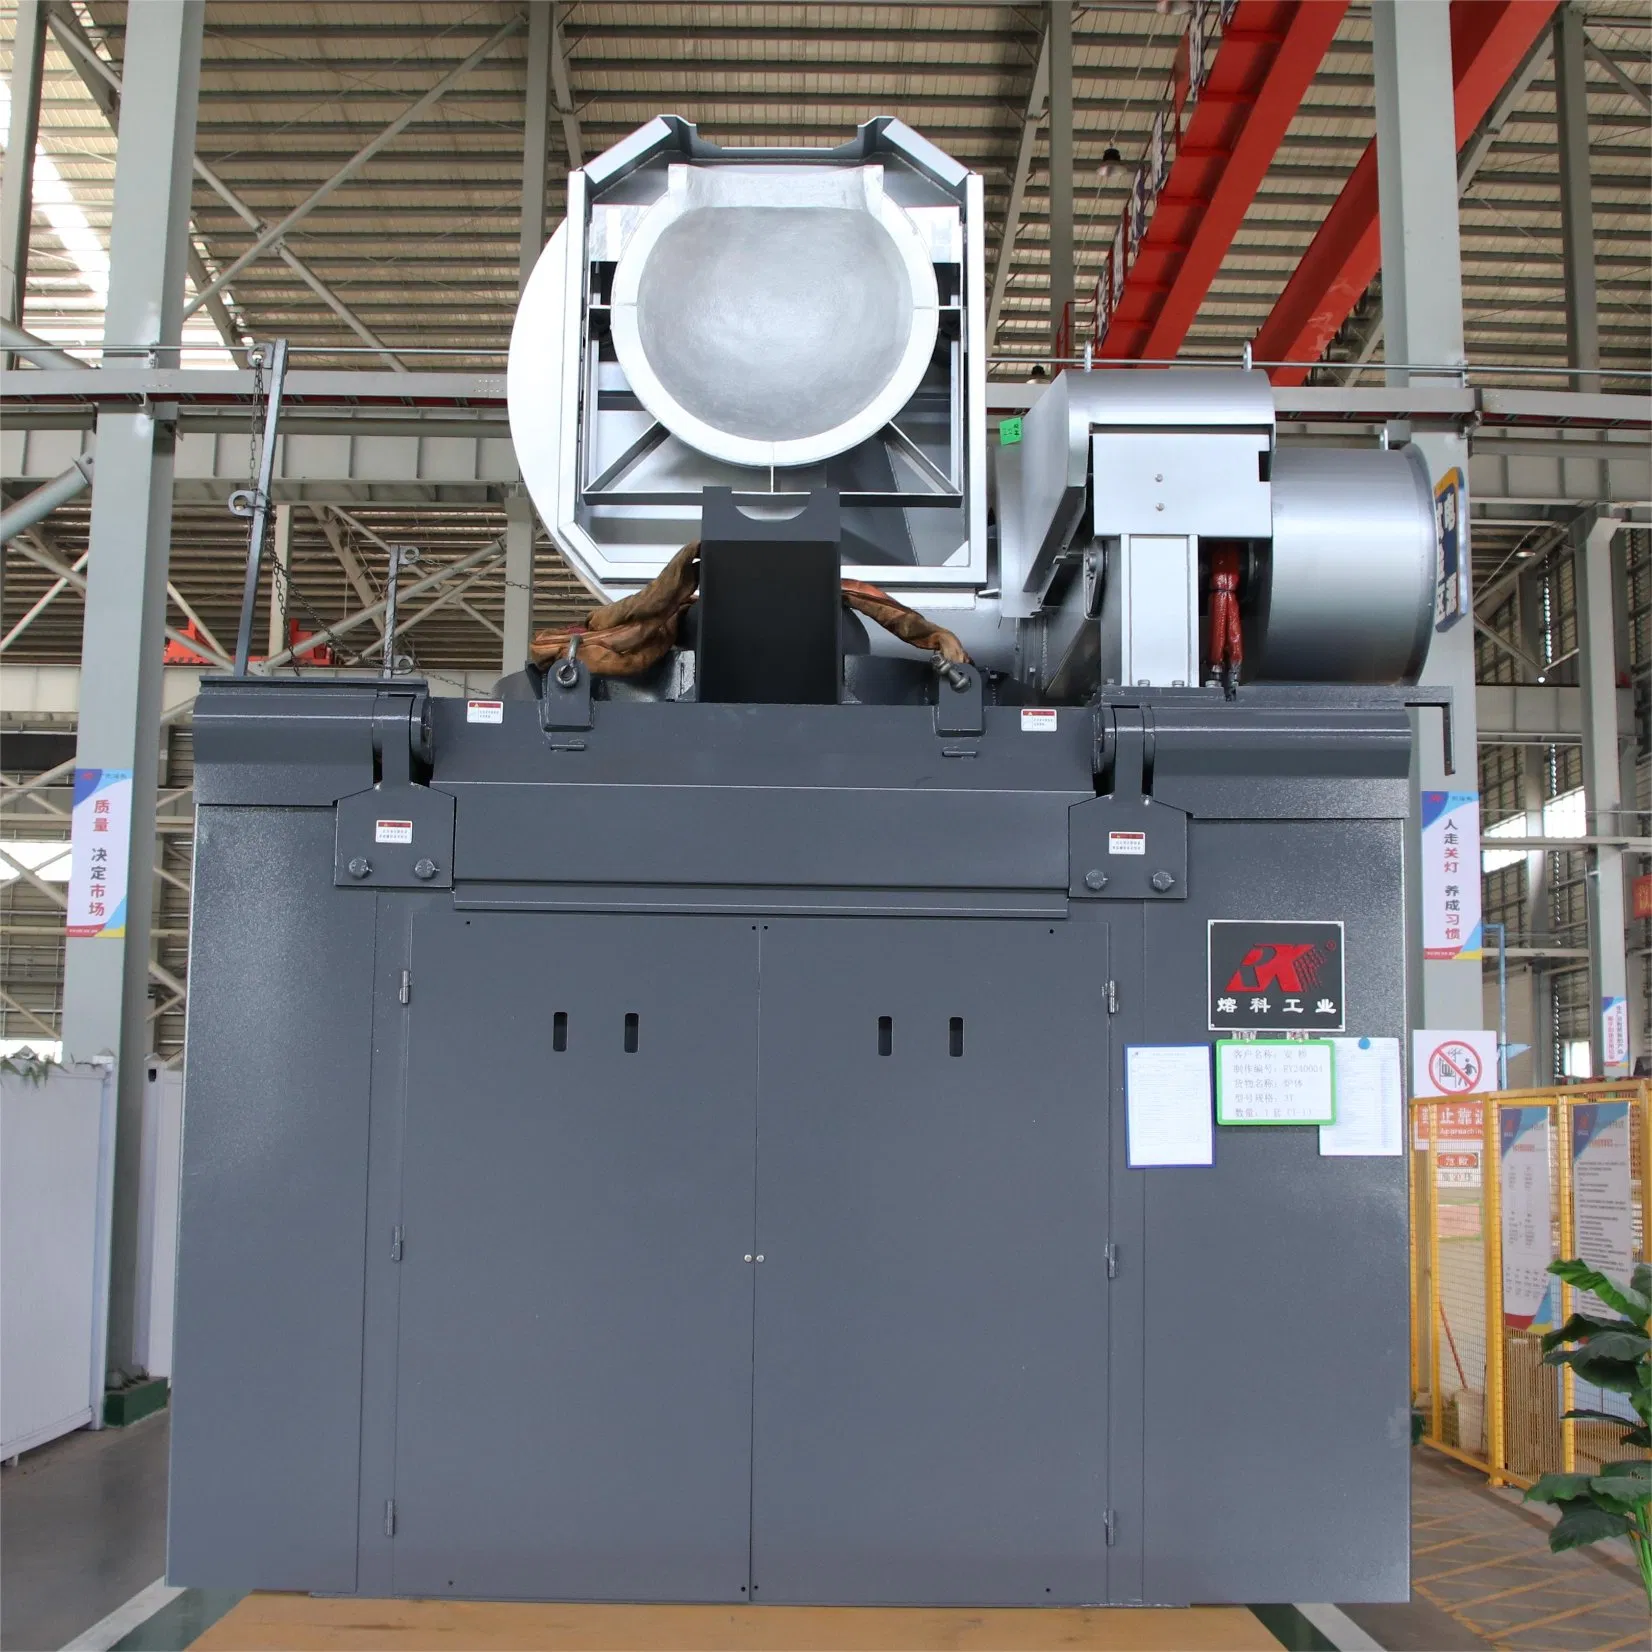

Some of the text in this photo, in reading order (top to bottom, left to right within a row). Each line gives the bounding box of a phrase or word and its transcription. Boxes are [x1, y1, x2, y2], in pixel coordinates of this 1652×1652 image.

[88, 799, 110, 917] 质量 决定市场
[1443, 818, 1461, 940] 人走关灯 养成习惯
[1216, 997, 1337, 1014] 熔科工业
[1439, 1128, 1484, 1136] Approachin
